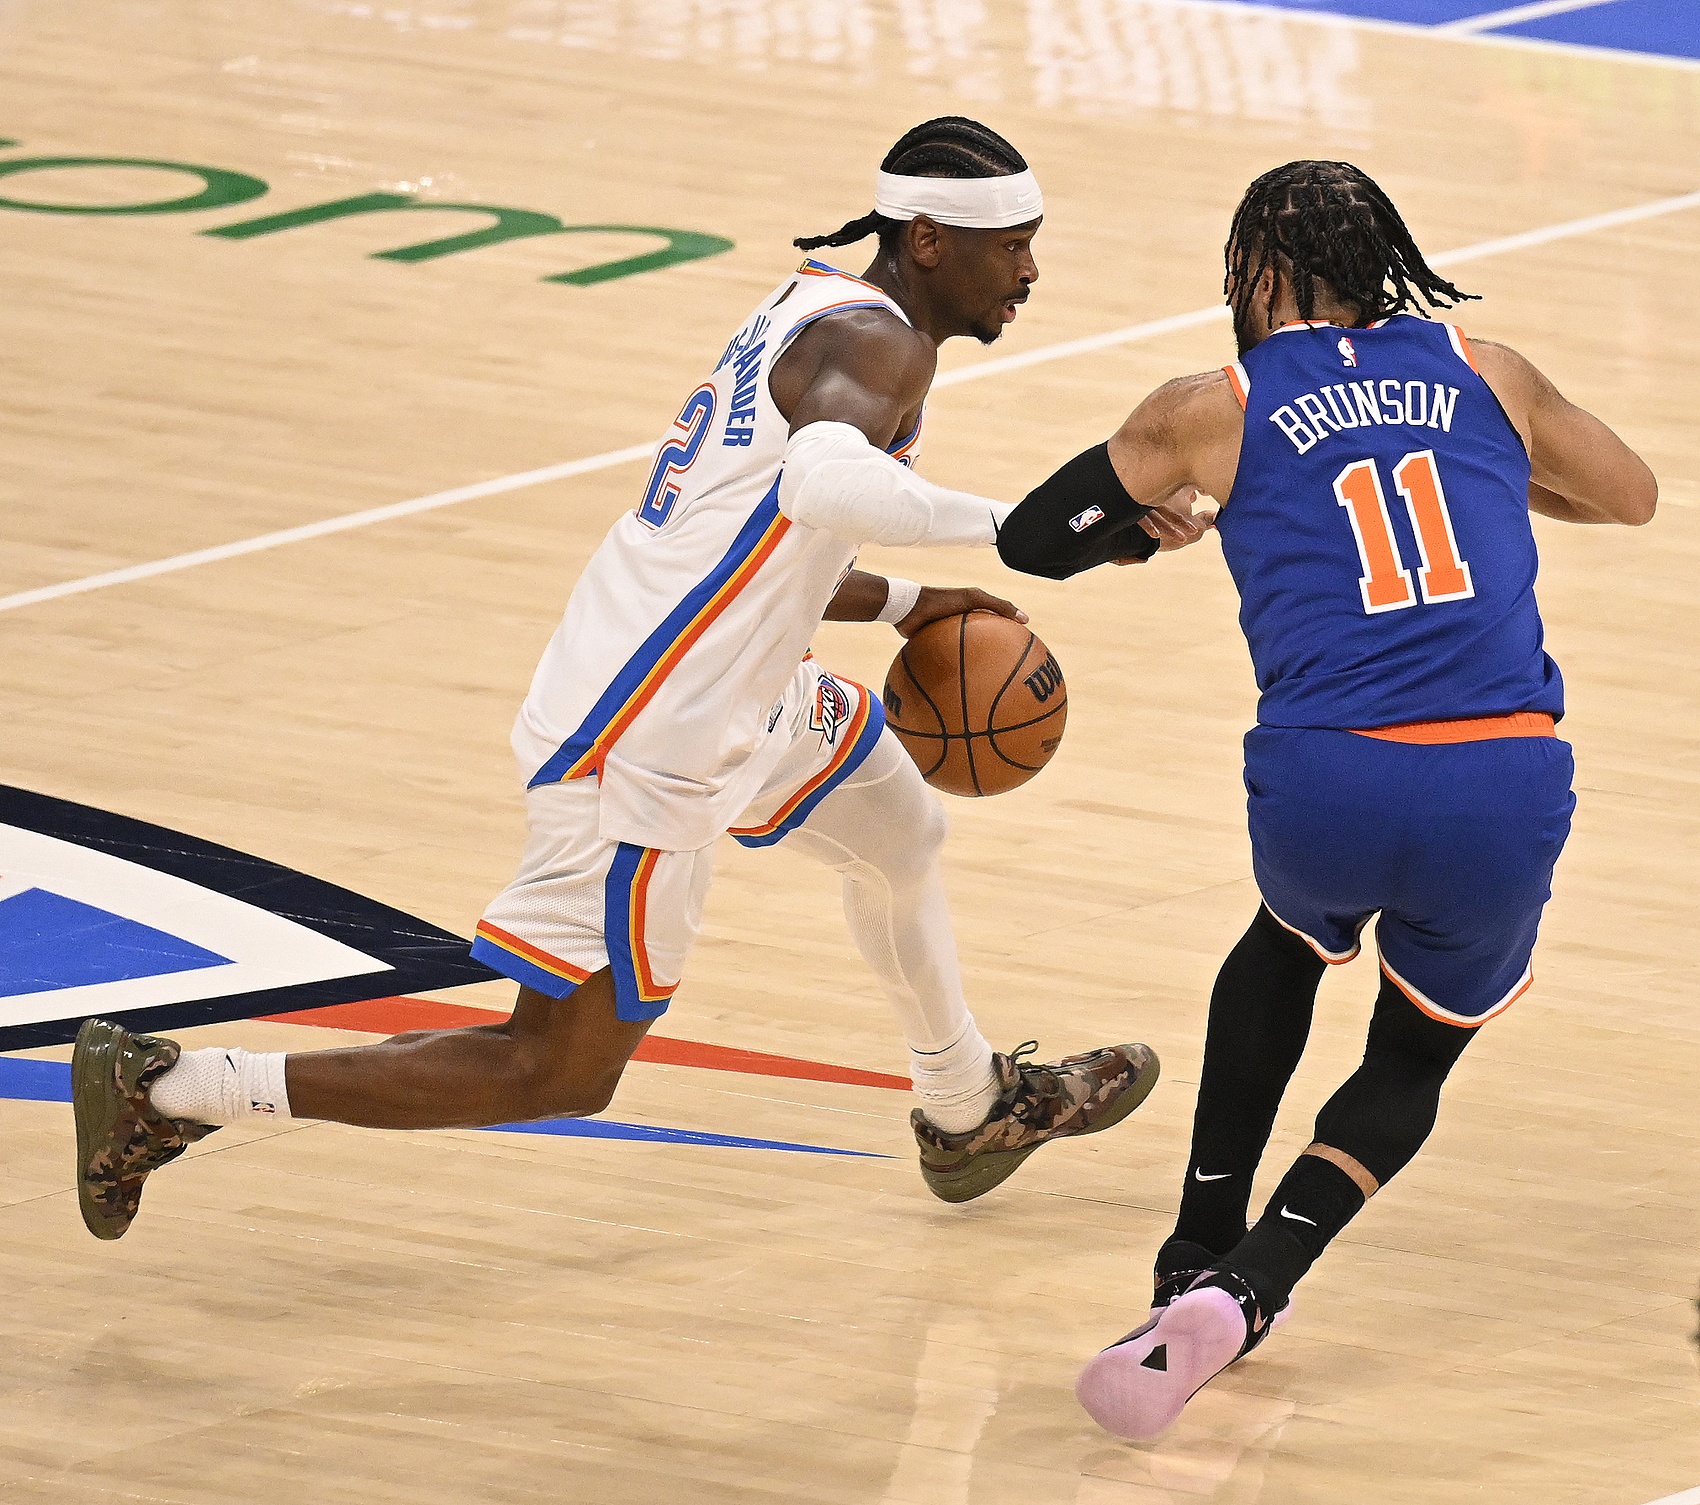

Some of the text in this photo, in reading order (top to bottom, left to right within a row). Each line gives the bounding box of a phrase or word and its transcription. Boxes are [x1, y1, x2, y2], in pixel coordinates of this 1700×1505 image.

[0, 138, 736, 287] om
[636, 382, 717, 531] 2
[1269, 379, 1460, 456] BRUNSON
[1332, 449, 1476, 615] 11
